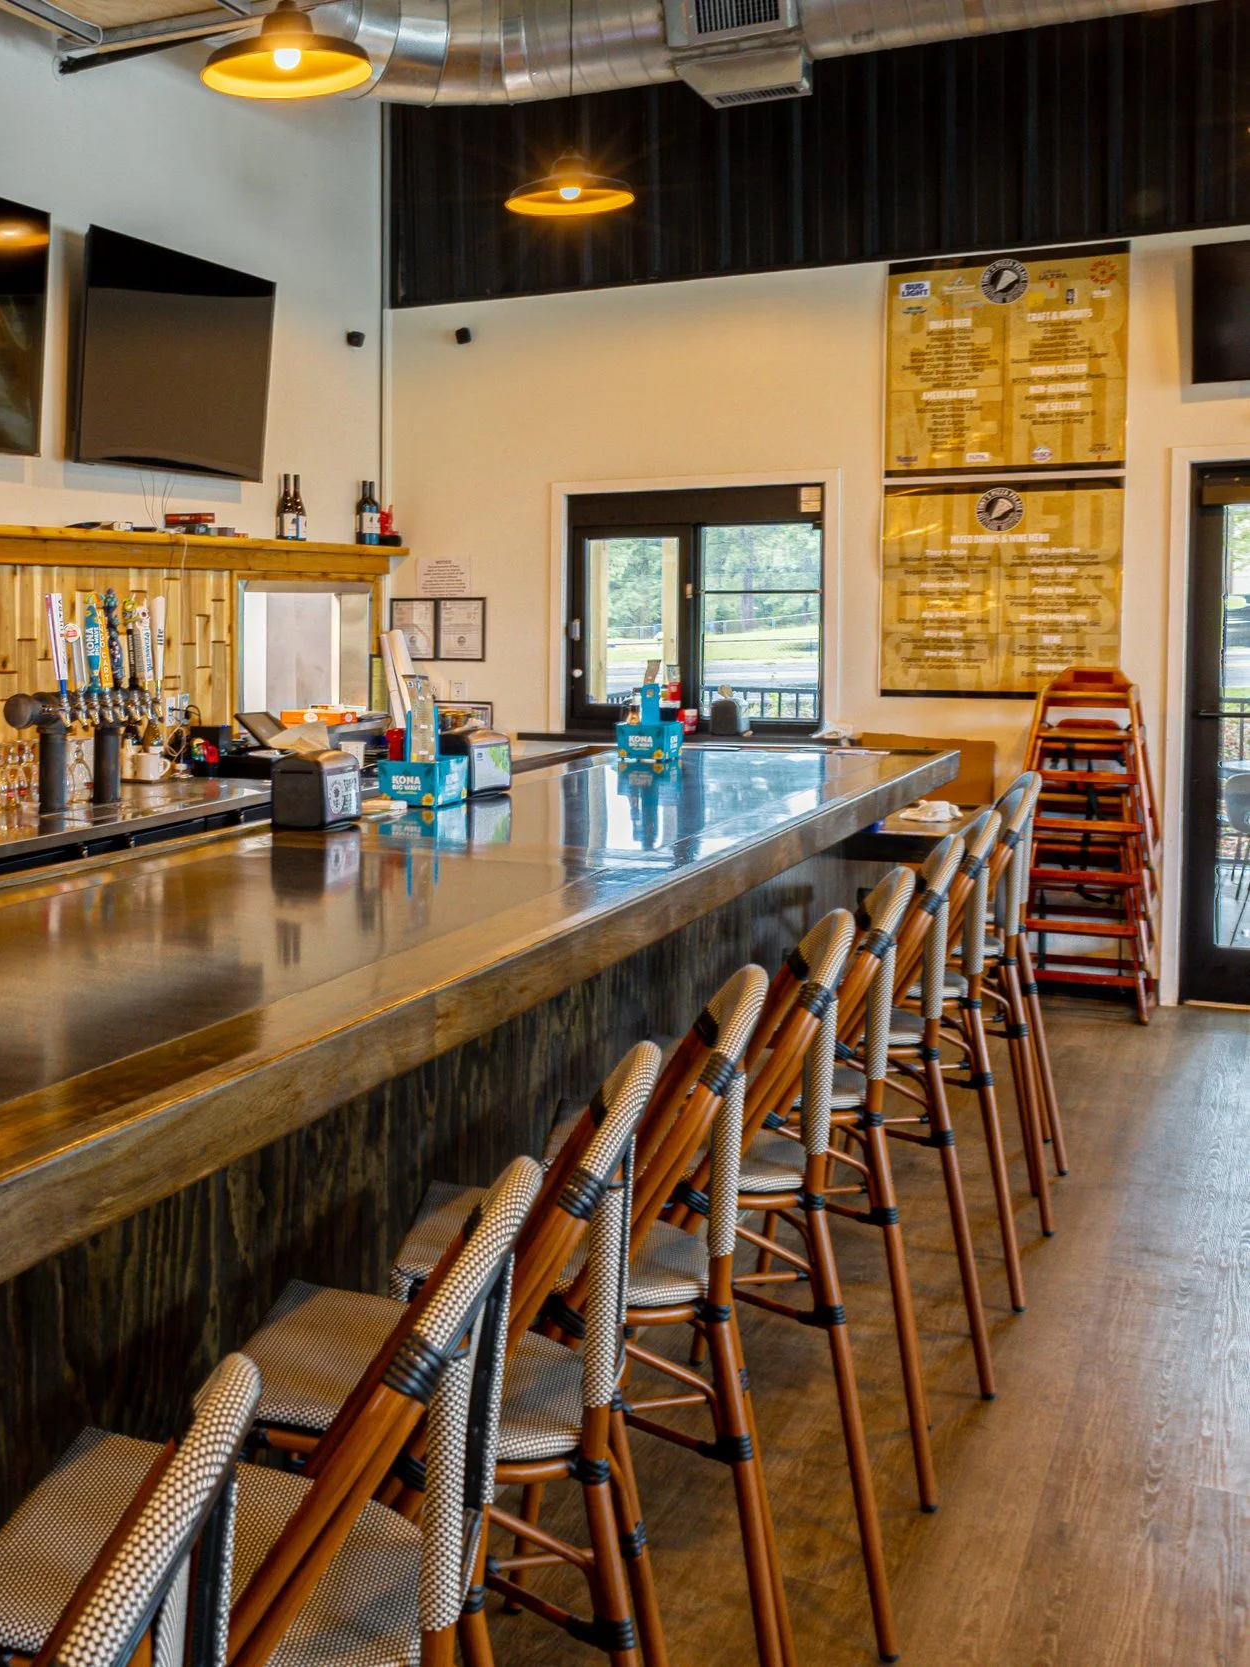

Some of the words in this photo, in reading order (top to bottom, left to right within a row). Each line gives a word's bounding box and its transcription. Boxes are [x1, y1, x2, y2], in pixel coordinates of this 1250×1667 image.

[906, 283, 925, 291] BUD
[902, 289, 929, 298] LIGHT
[85, 627, 94, 656] KONA
[101, 651, 111, 682] CART
[391, 775, 421, 785] KONA
